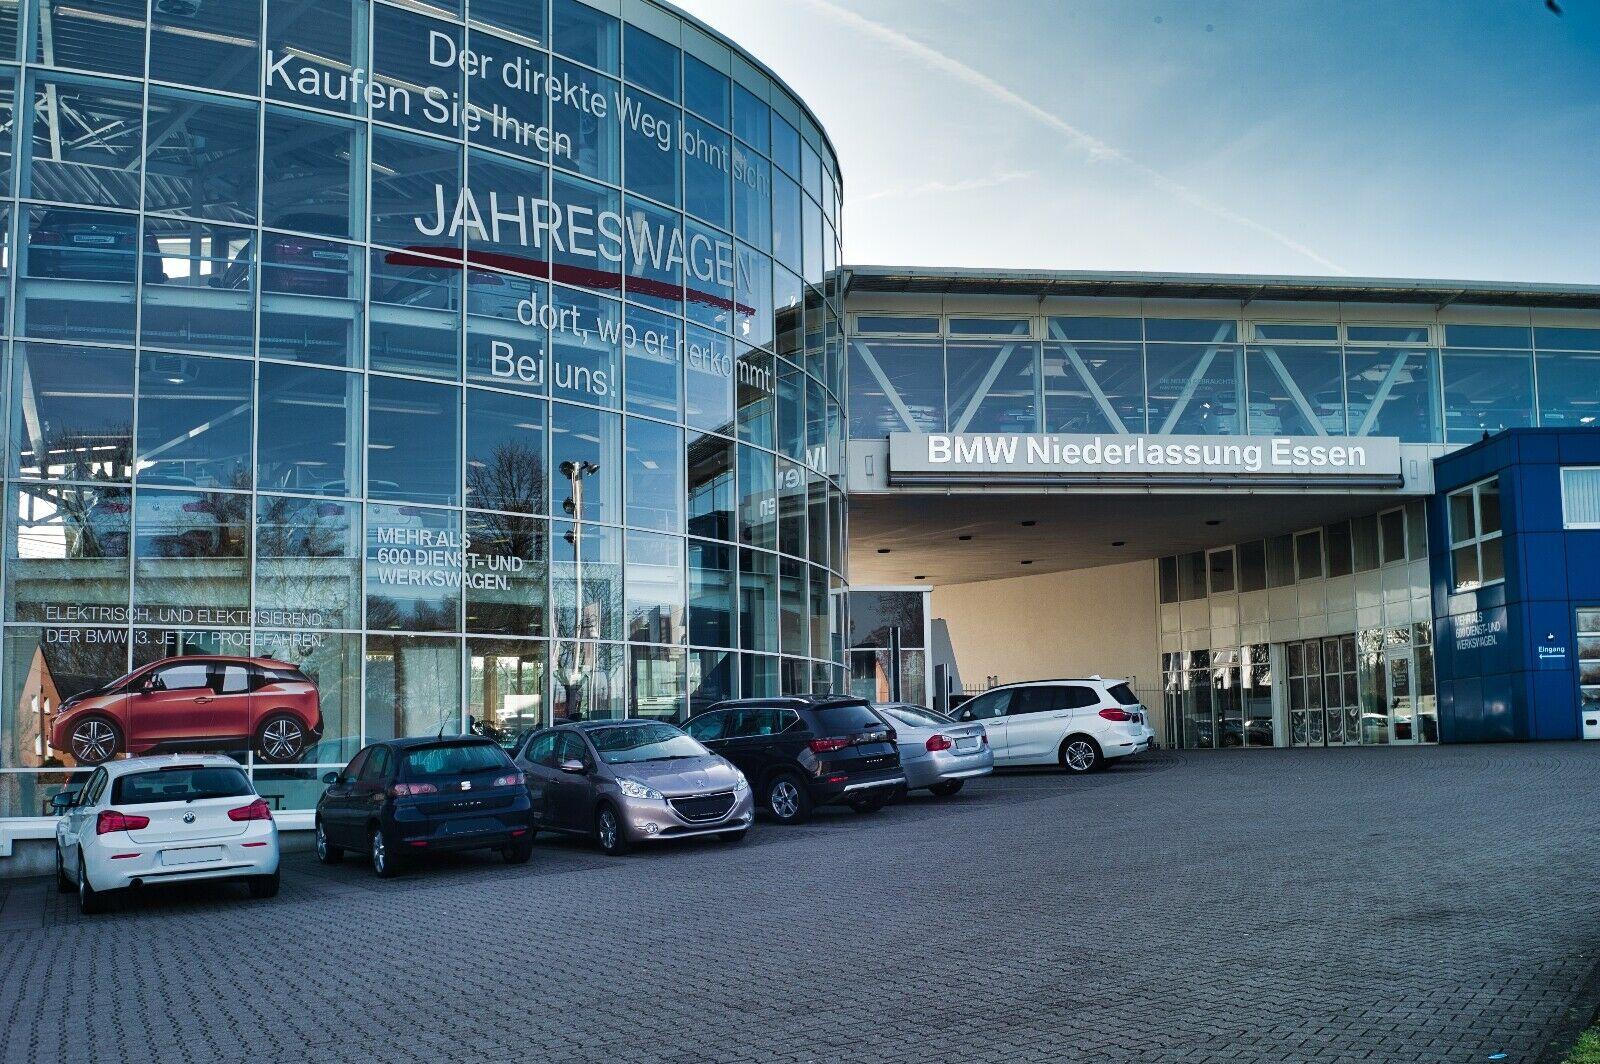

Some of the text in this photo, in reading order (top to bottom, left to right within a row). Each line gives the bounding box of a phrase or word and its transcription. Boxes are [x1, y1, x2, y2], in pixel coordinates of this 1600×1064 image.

[266, 50, 572, 159] Kaufen Sie Ihren
[429, 30, 493, 79] Der
[502, 56, 607, 118] direkte
[614, 91, 671, 152] Weg
[678, 119, 729, 174] lohnt
[414, 183, 753, 294] JAHRESWAGEN
[516, 292, 775, 396] dort, wo er herkommt.
[490, 340, 616, 398] Bei uns!
[927, 435, 1367, 472] BMW Niederlassung Essen
[377, 526, 472, 549] MEHR ALS
[377, 547, 524, 572] 600 DIENST- UND
[377, 567, 512, 591] WERKSWAGEN.
[46, 606, 324, 626] ELEKTRISCH. UND ELEKTRISIEREND.
[46, 629, 325, 648] DER BMW i3. JETZT PROBEFAHREN.
[1538, 645, 1565, 654] Eingang
